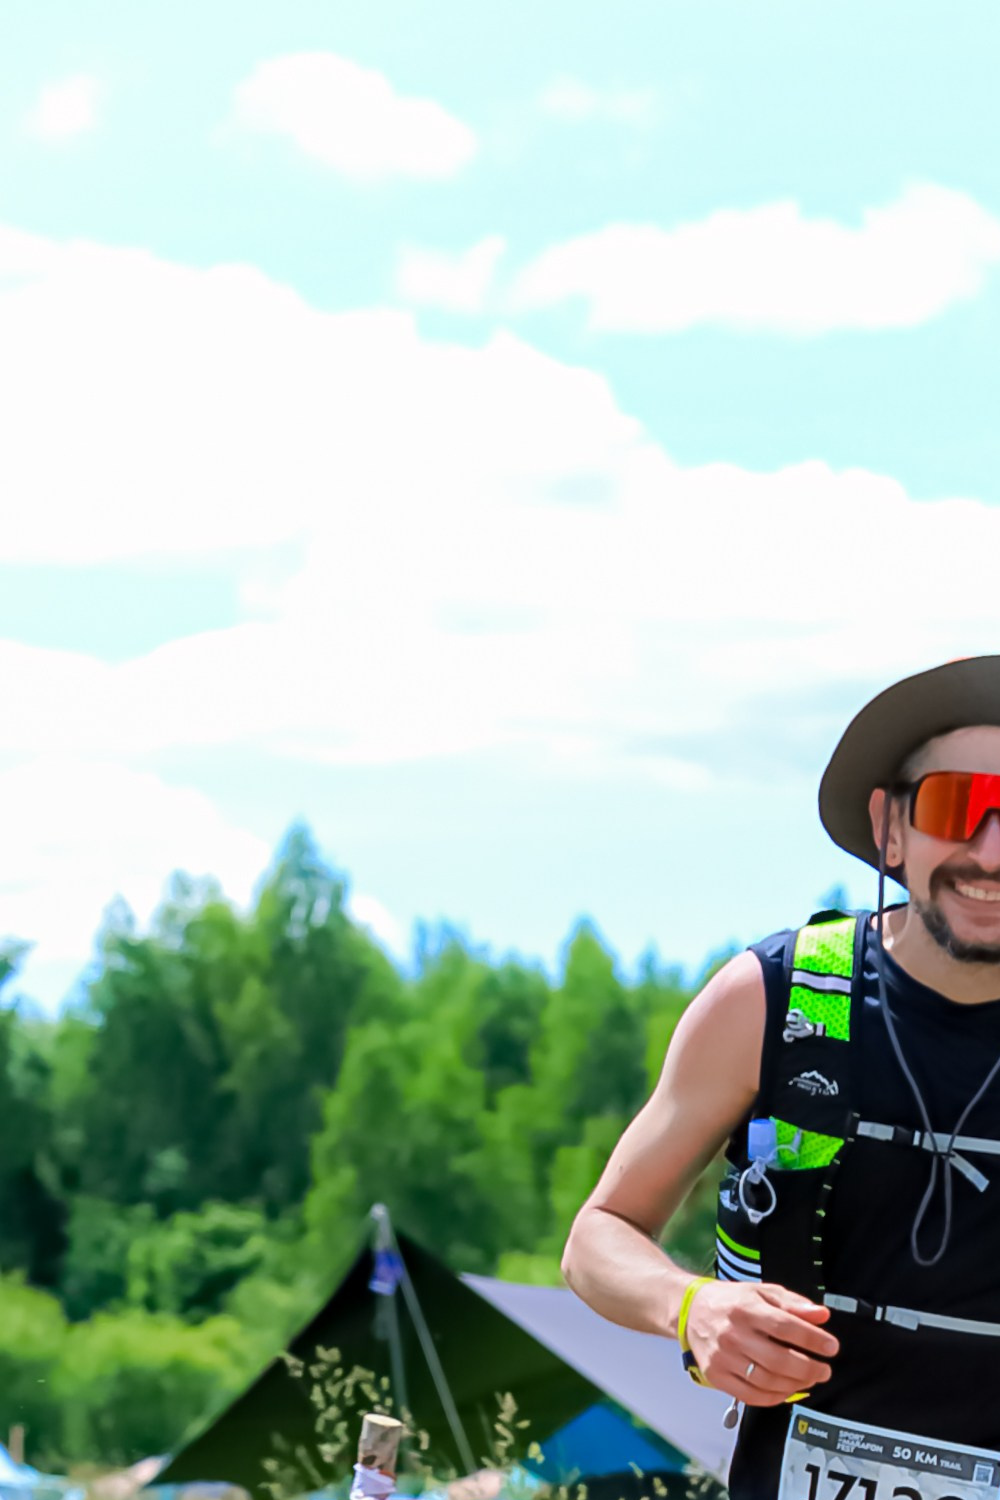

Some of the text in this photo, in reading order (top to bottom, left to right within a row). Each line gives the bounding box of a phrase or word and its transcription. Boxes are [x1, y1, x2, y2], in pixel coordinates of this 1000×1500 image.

[838, 1430, 865, 1443] SPORT
[836, 1442, 856, 1454] FEST
[892, 1445, 912, 1460] 50
[914, 1450, 938, 1466] KM
[939, 1459, 963, 1471] TRAIL
